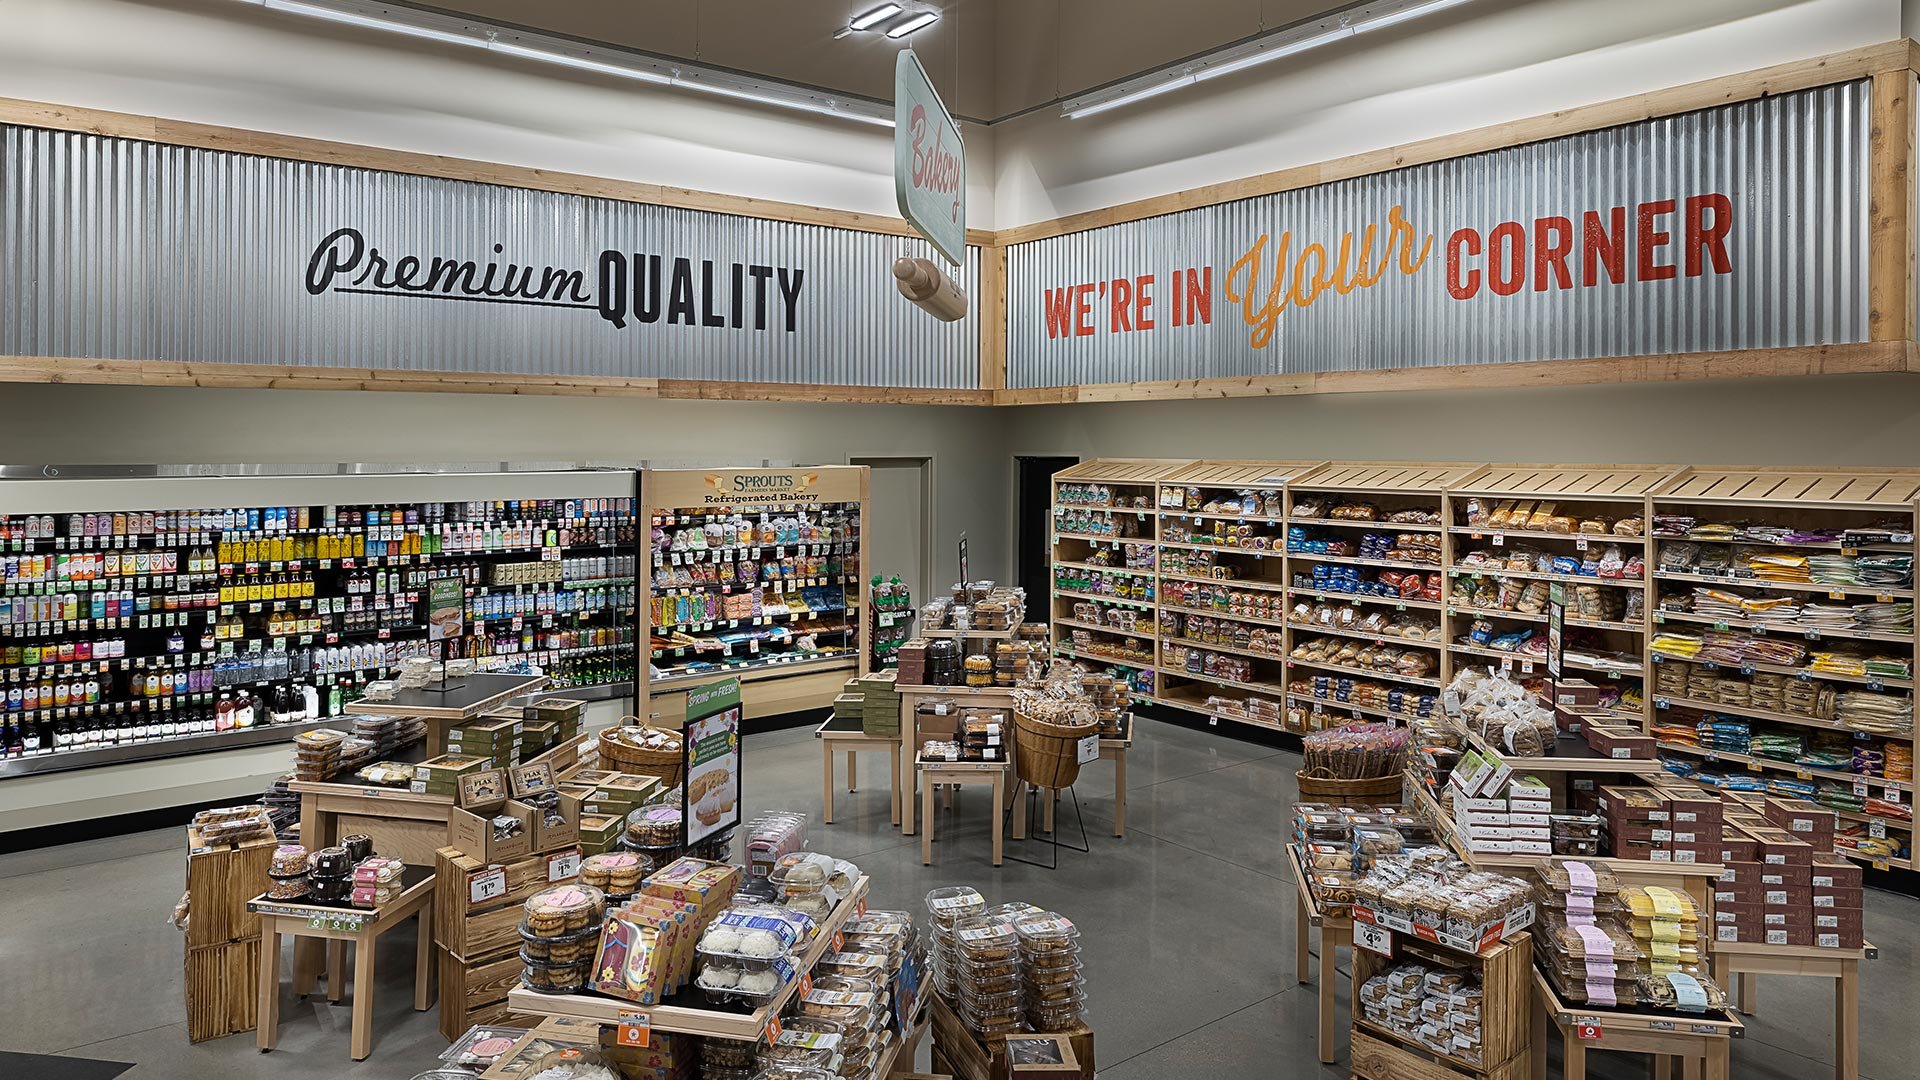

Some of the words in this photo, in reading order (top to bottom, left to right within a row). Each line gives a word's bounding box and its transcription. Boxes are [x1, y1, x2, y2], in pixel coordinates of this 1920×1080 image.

[910, 103, 961, 224] Bakery
[305, 227, 592, 302] Premium
[598, 248, 805, 333] QUALITY
[1044, 275, 1156, 340] WE'RE
[1171, 265, 1212, 327] IN
[1224, 204, 1435, 350] Your
[1446, 192, 1733, 301] CORNER
[704, 494, 778, 504] Refrigerated
[779, 493, 819, 502] Bakery
[733, 474, 793, 492] SPROUTS
[688, 691, 710, 707] SPRING
[717, 682, 738, 697] FRESH!
